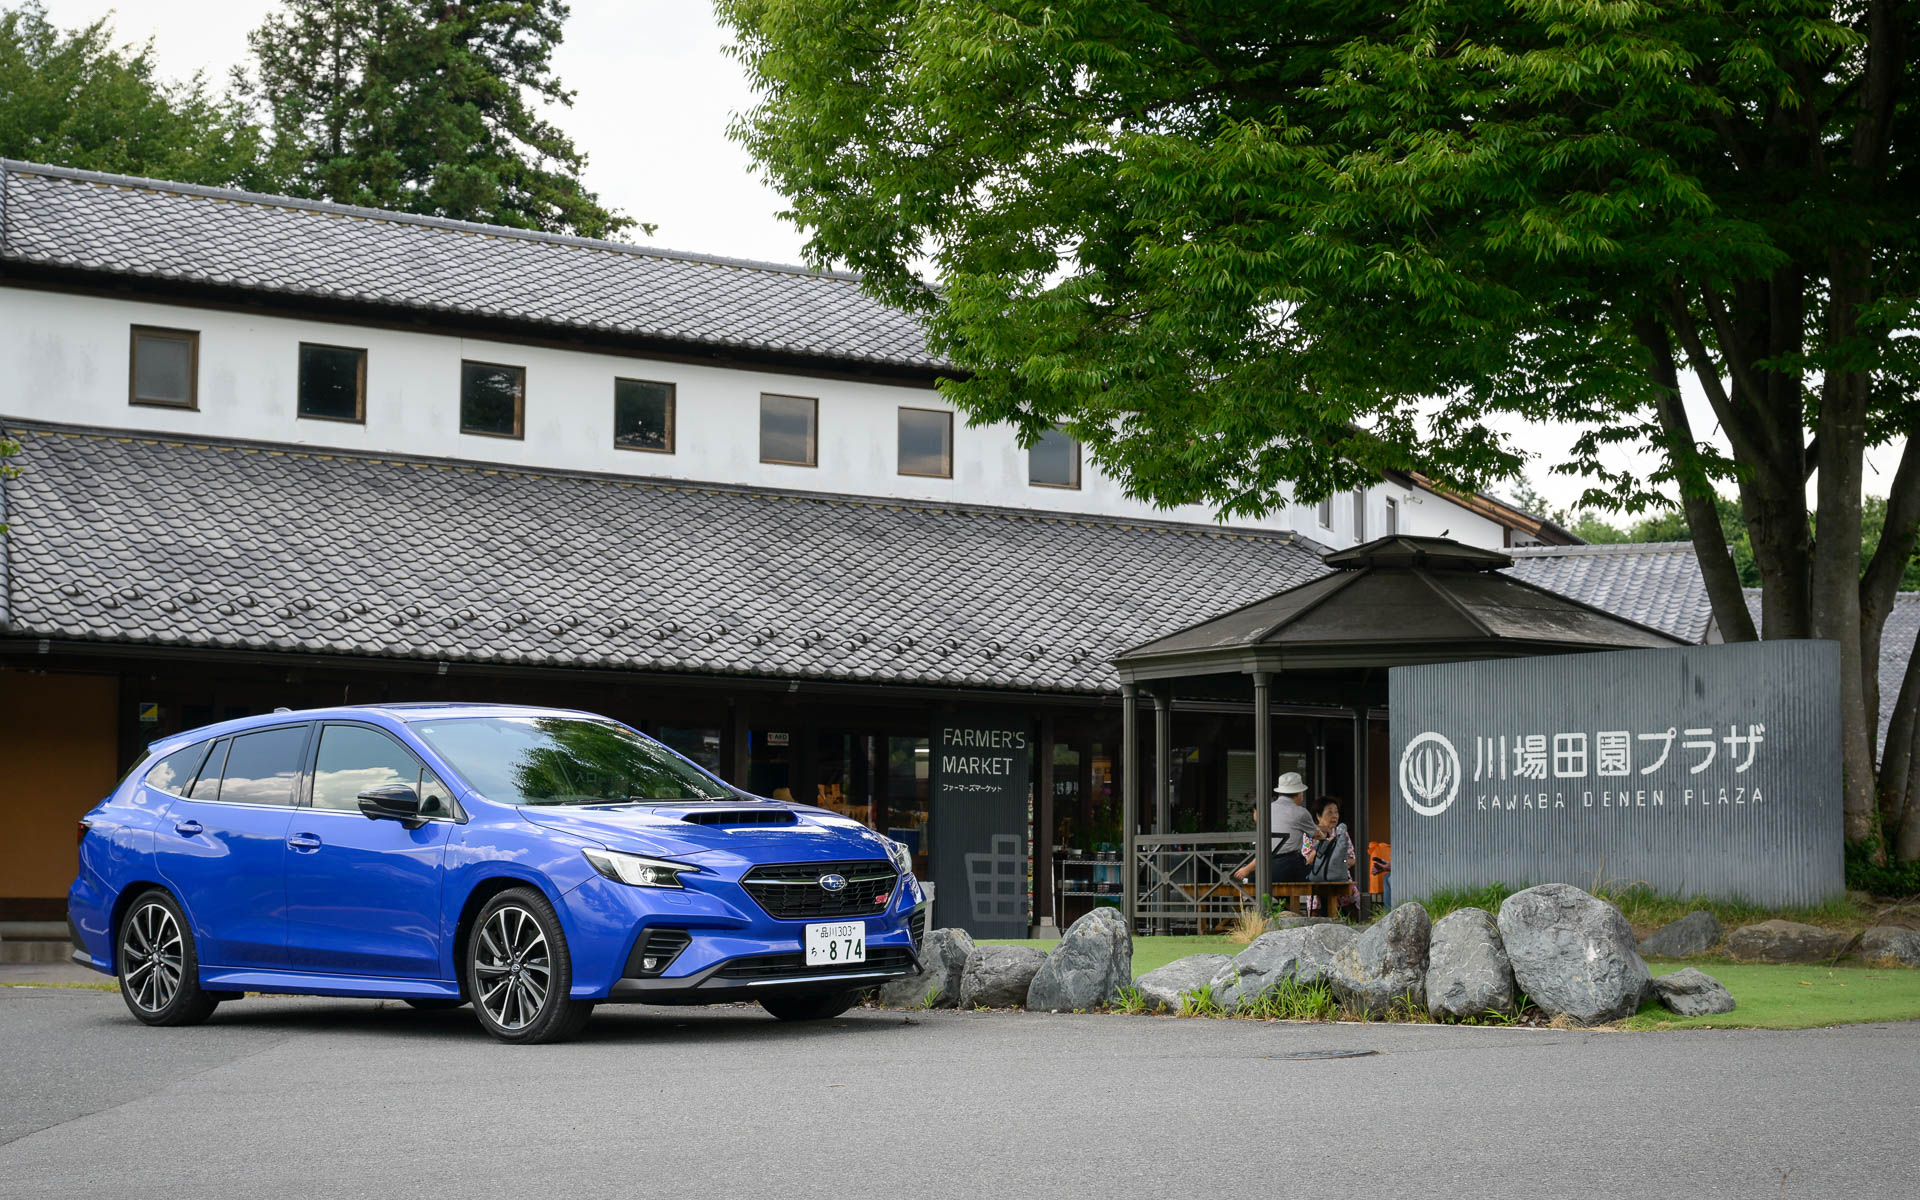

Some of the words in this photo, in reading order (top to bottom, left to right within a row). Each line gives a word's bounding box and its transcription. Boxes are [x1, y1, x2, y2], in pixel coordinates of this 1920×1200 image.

[943, 728, 1025, 749] FARMER'S
[1474, 722, 1766, 782] 川場田園プラザ
[942, 756, 1013, 775] MARKET
[943, 784, 1002, 792] ファーマーズマーケット
[1477, 792, 1565, 811] KAWABA
[1583, 790, 1664, 808] DENEN
[1684, 787, 1763, 806] PLAZA
